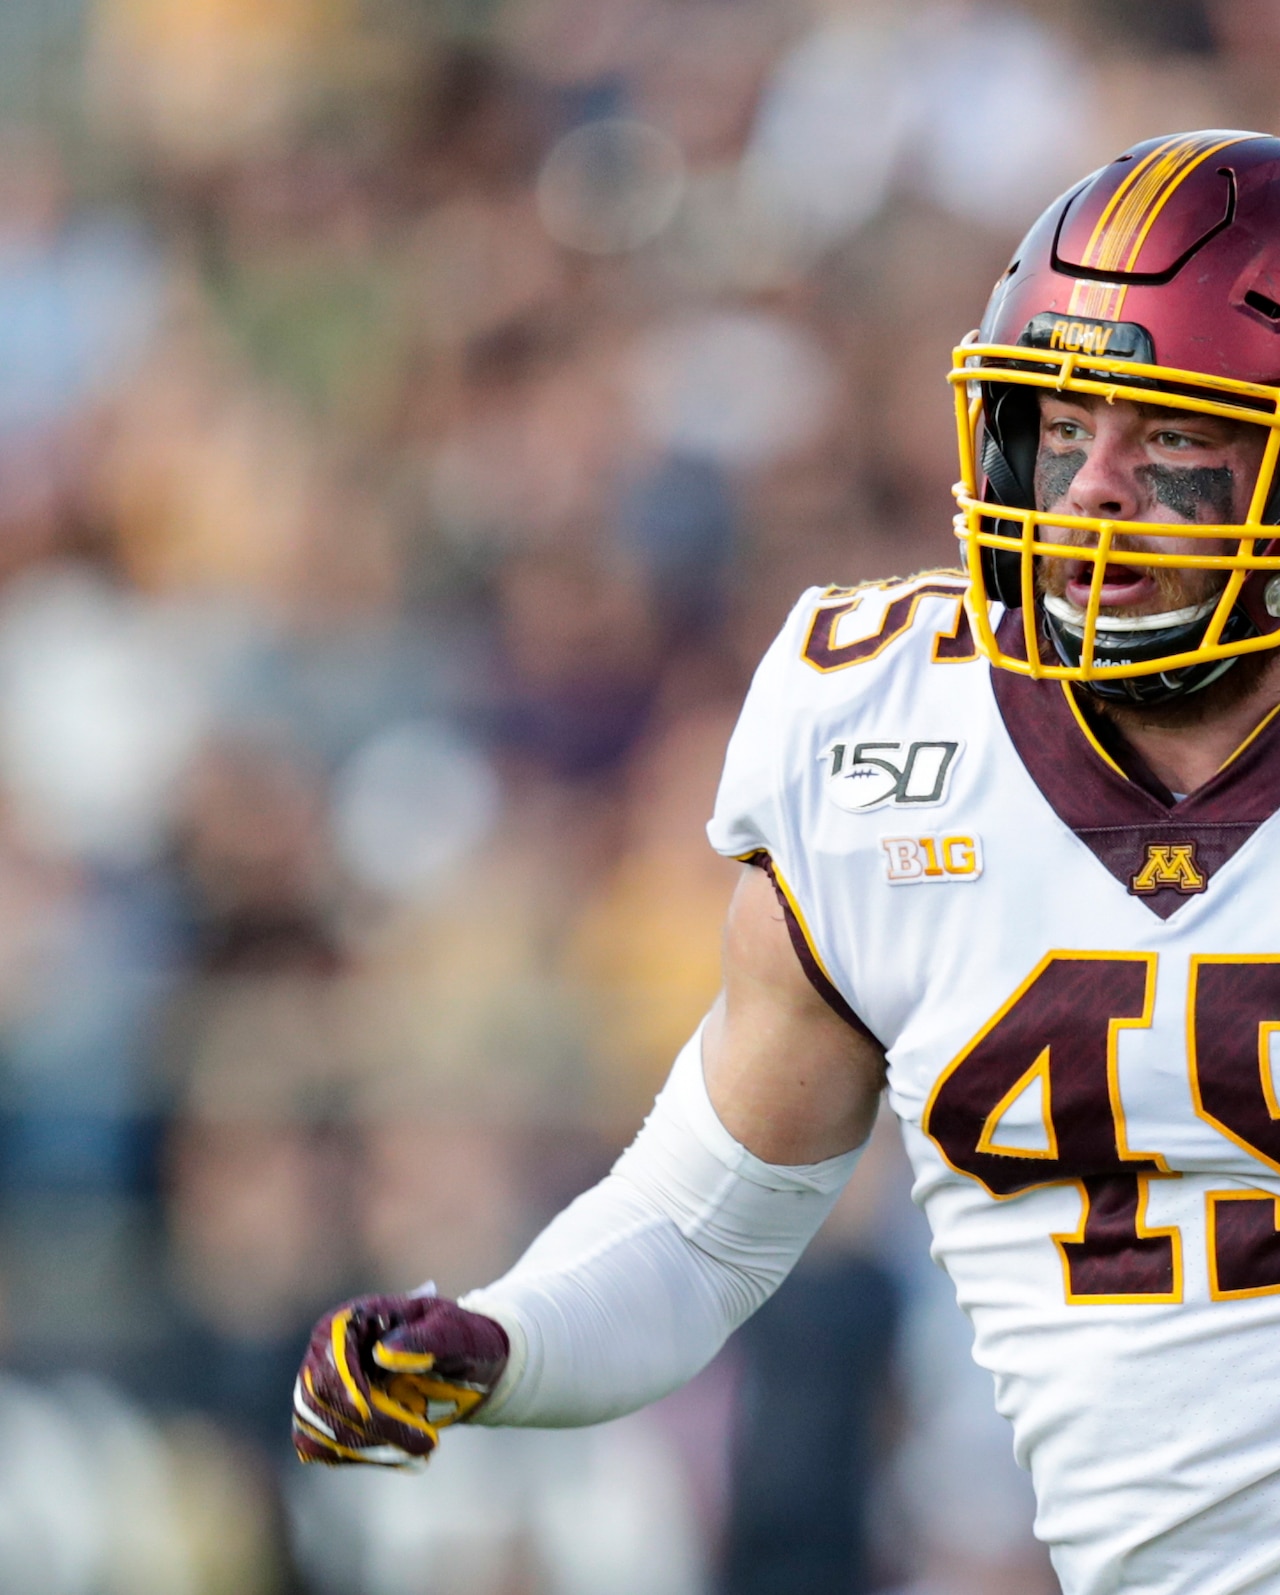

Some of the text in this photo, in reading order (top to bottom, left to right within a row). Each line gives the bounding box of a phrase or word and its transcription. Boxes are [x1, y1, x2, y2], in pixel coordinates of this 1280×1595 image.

[1049, 320, 1114, 356] ROW
[831, 741, 959, 808] 150
[1132, 844, 1204, 892] M
